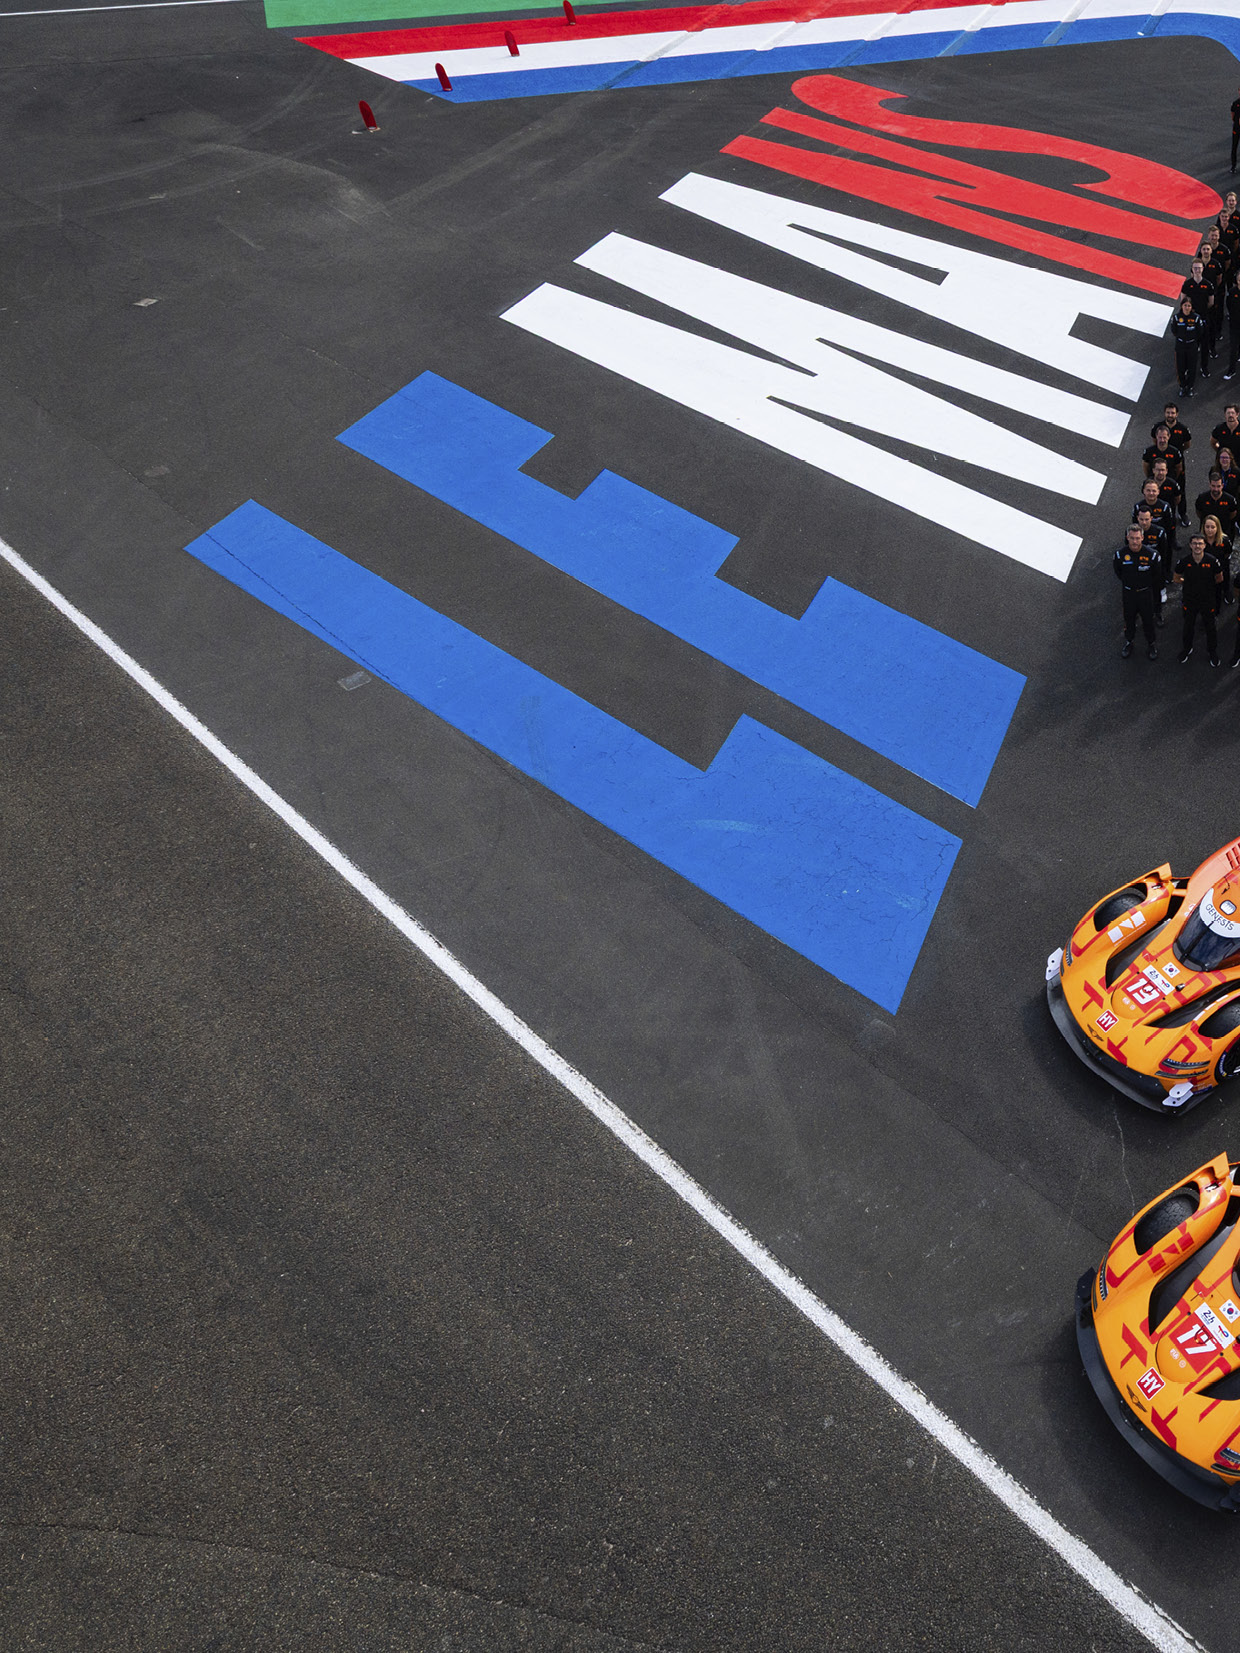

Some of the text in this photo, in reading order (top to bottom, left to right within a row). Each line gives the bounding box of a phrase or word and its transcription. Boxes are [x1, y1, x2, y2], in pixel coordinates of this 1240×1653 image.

[183, 74, 1224, 1015] LE MANS
[1205, 903, 1235, 931] GENESIS
[1126, 977, 1160, 1005] 19
[1098, 1012, 1116, 1028] HY
[1176, 1323, 1217, 1355] 17
[1140, 1371, 1161, 1393] HY
